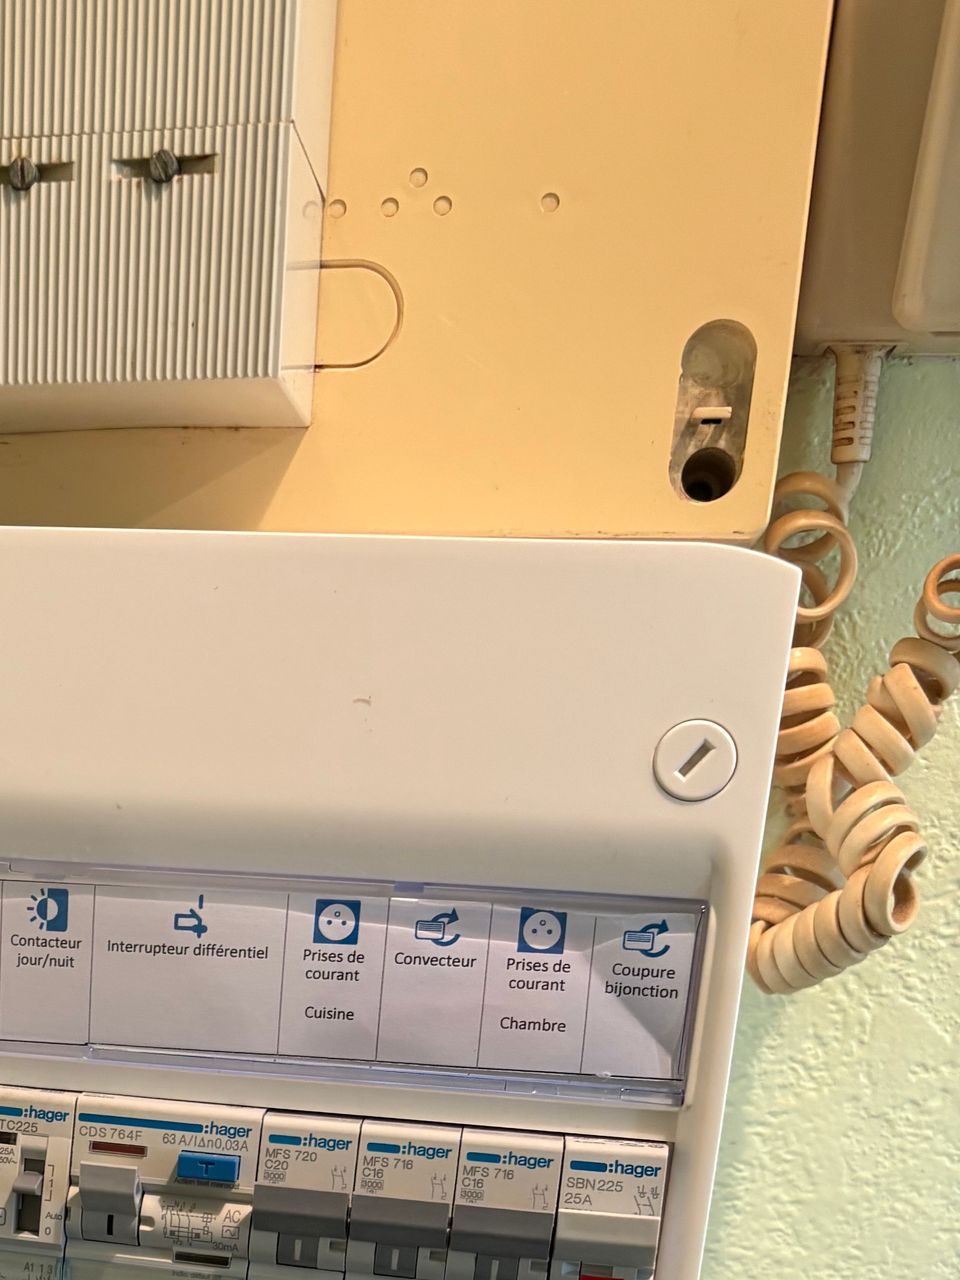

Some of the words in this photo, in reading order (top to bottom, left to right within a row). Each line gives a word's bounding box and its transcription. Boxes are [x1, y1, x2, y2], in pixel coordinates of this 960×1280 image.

[10, 935, 82, 949] Contacteur
[107, 940, 190, 957] Interrupteur
[193, 944, 268, 959] différentiel
[303, 950, 343, 963] Prises
[347, 950, 365, 963] de
[16, 953, 74, 968] jour/nuit
[394, 952, 477, 968] Convecteur
[506, 958, 548, 973] Prises
[552, 959, 571, 973] de
[305, 968, 360, 981] courant
[612, 963, 676, 982] Coupure
[509, 978, 565, 991] courant
[604, 981, 678, 999] bijonction
[305, 1006, 354, 1021] Cuisine
[500, 1017, 567, 1032] Chambre
[79, 1126, 107, 1137] CDS
[110, 1128, 142, 1141] 764F
[265, 1148, 291, 1160] MFS
[295, 1150, 317, 1162] 720
[264, 1159, 288, 1170] C20
[363, 1156, 389, 1167] MFS
[393, 1158, 413, 1170] 716
[362, 1167, 384, 1179] C16
[463, 1166, 490, 1178] MFS
[494, 1168, 514, 1180] 716
[462, 1177, 484, 1188] C16
[564, 1193, 592, 1206] 25A
[45, 1212, 62, 1220] Auto
[223, 1211, 241, 1222] AC
[24, 1262, 33, 1272] A1
